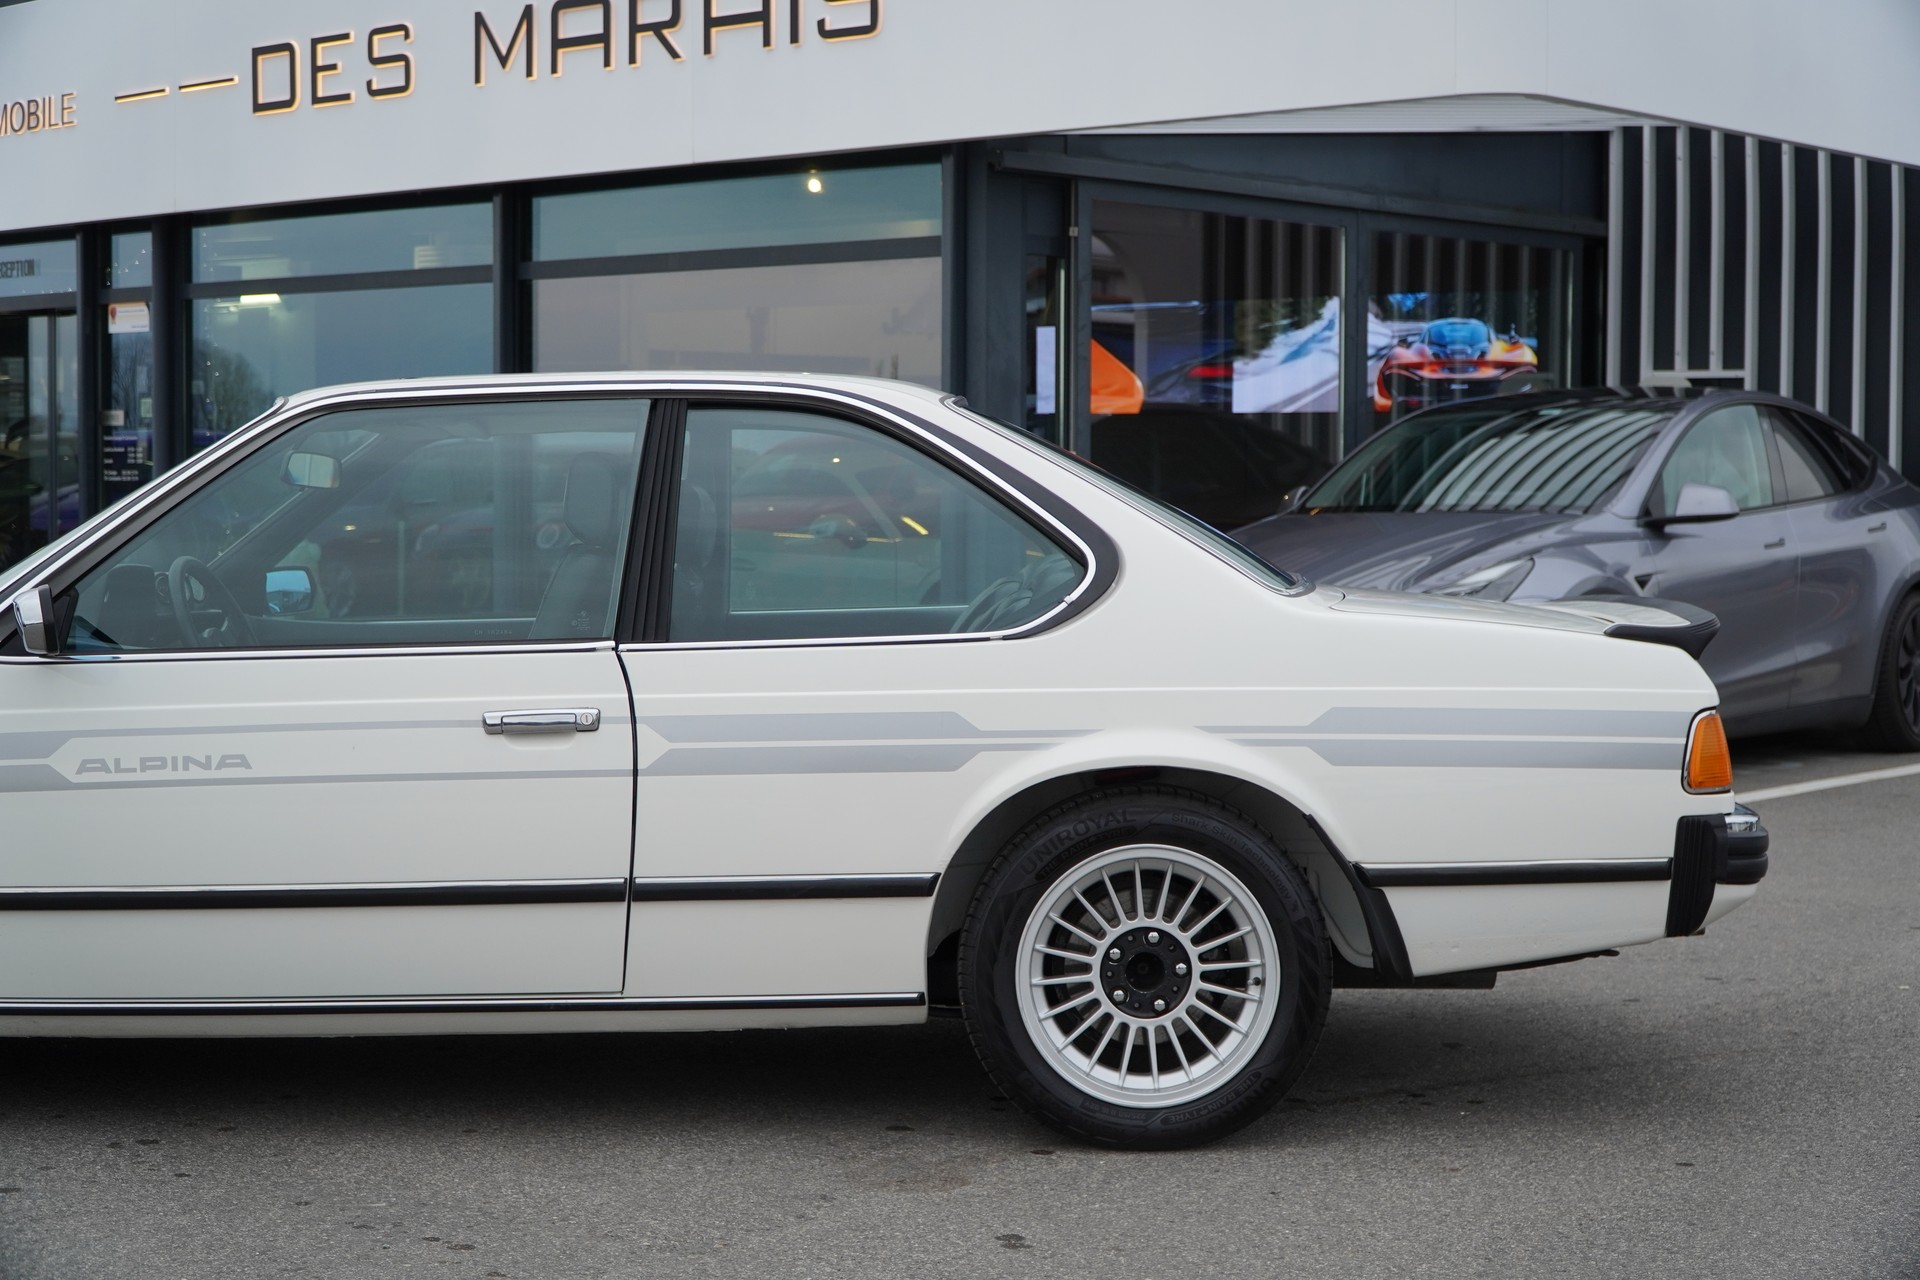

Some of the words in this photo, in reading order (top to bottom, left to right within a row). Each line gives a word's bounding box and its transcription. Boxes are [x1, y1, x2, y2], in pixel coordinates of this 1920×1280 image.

[251, 23, 413, 114] DES
[75, 753, 253, 776] ALPINA
[1020, 809, 1137, 876] UNIROYAL
[1170, 811, 1210, 832] Shark
[1209, 823, 1240, 846] Skin
[1238, 841, 1293, 902] Technology
[1235, 1072, 1258, 1094] THE
[1206, 1090, 1237, 1113] RAIN
[1166, 1108, 1199, 1125] TYRE
